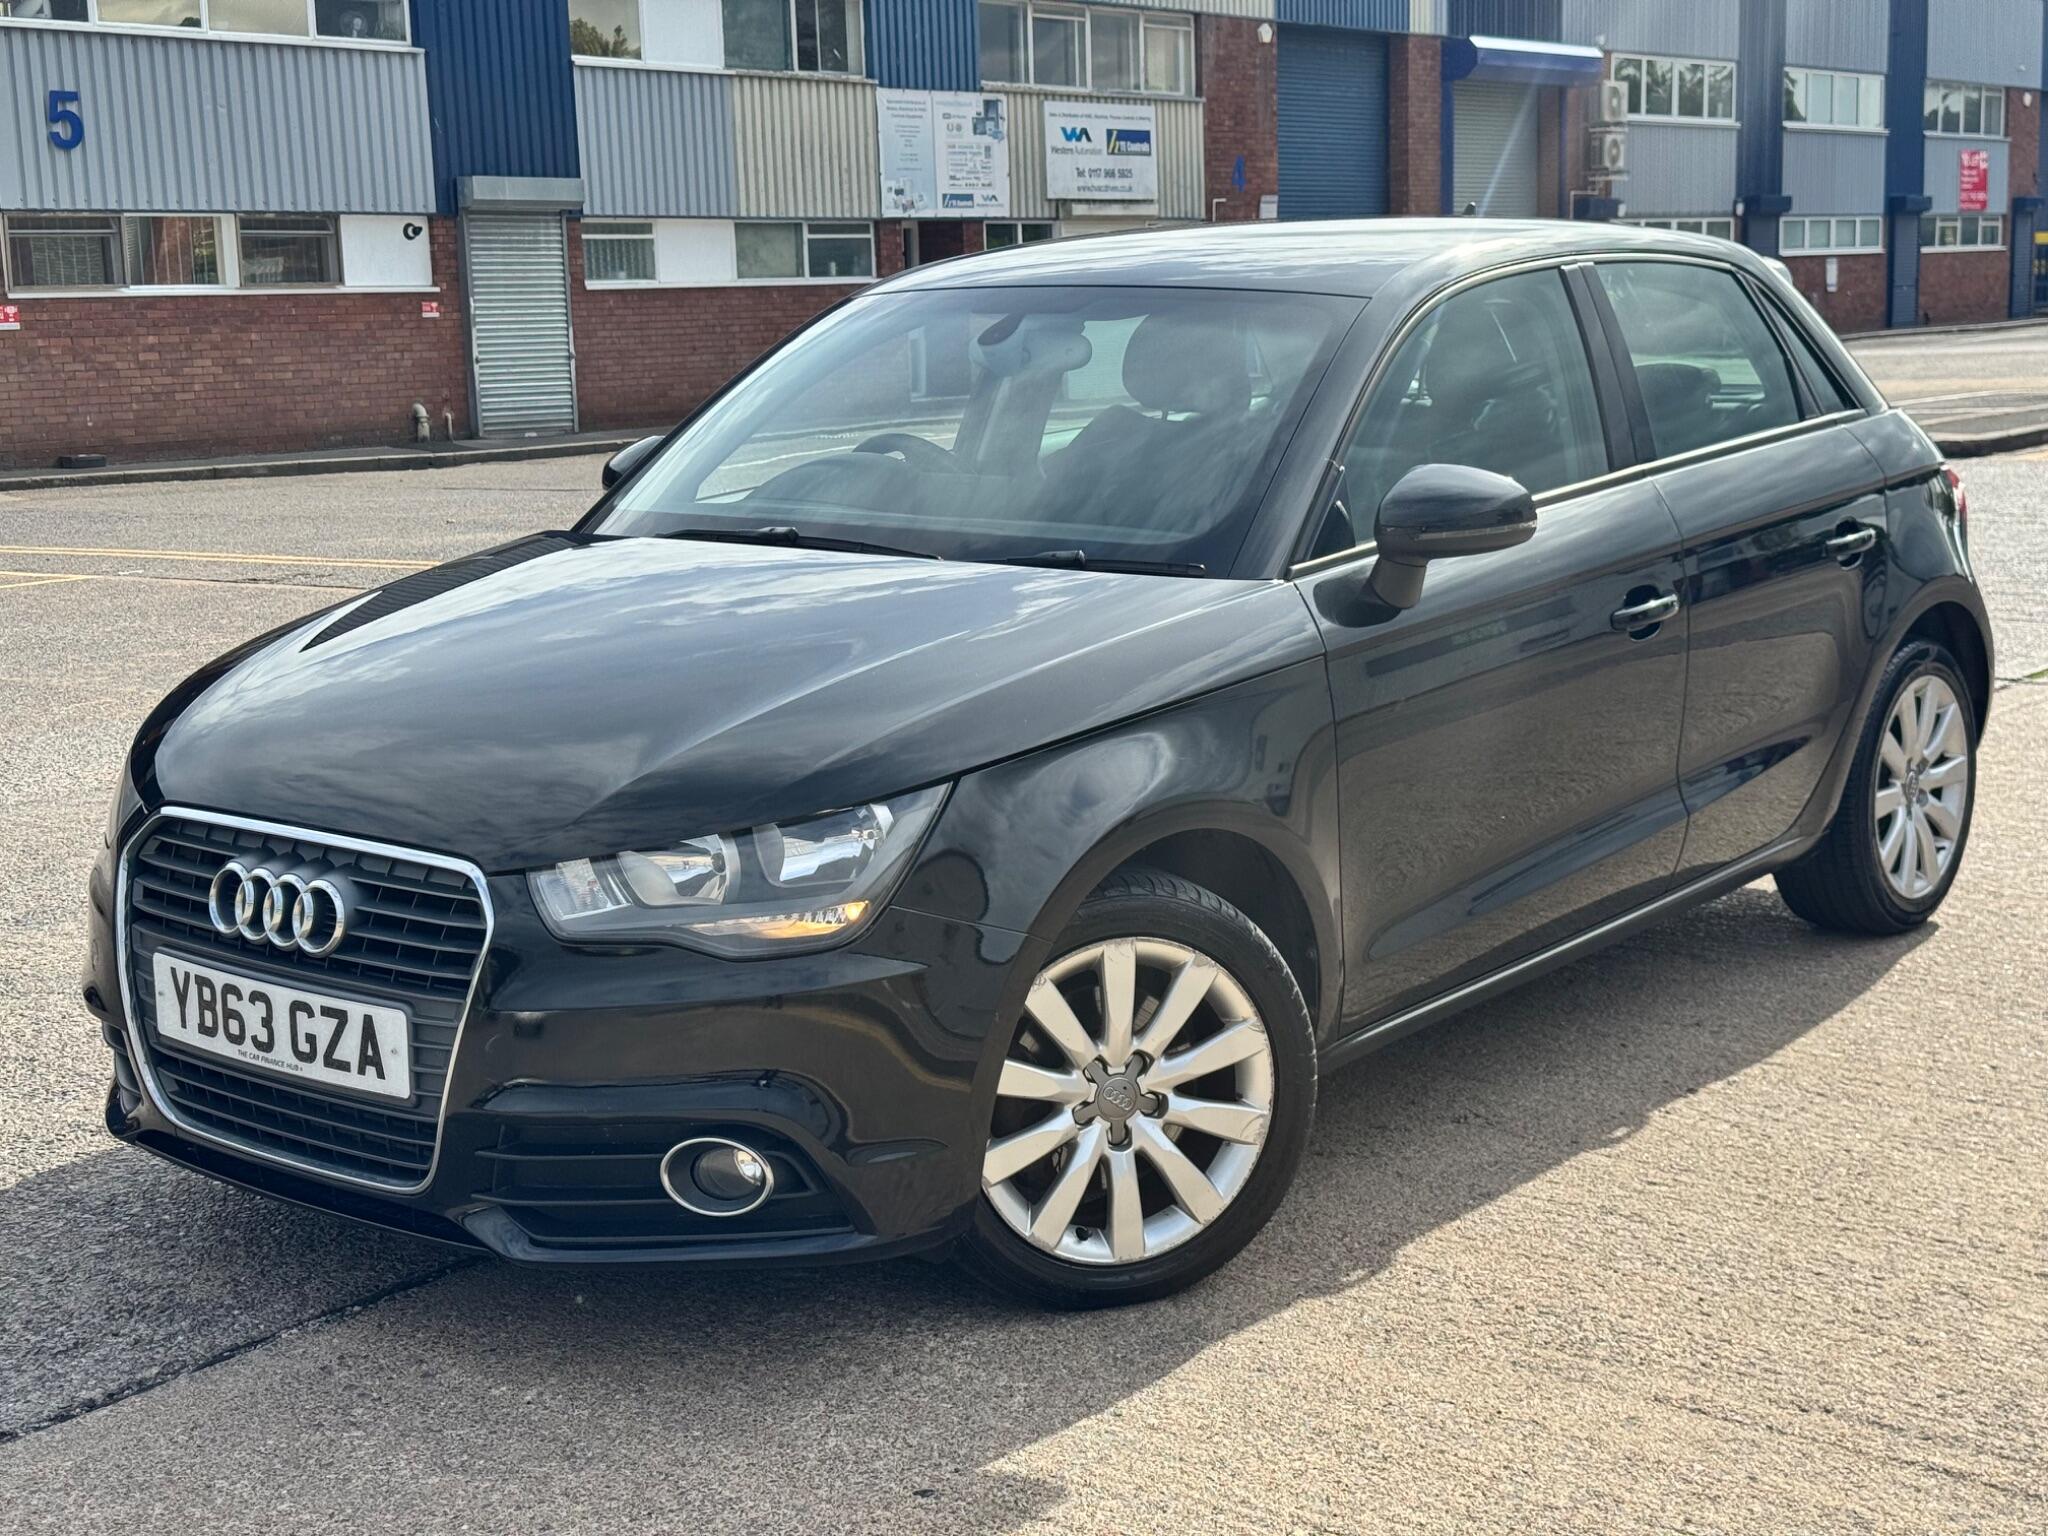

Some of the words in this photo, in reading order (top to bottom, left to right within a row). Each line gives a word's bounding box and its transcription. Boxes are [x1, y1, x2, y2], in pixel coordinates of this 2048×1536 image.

[49, 90, 84, 150] 5
[1060, 127, 1092, 142] WA
[1232, 153, 1246, 192] 4
[170, 966, 275, 1053] YB63
[289, 1000, 386, 1080] GZA
[238, 1049, 248, 1059] THE
[249, 1052, 260, 1062] CAR
[261, 1055, 285, 1068] FINANCE
